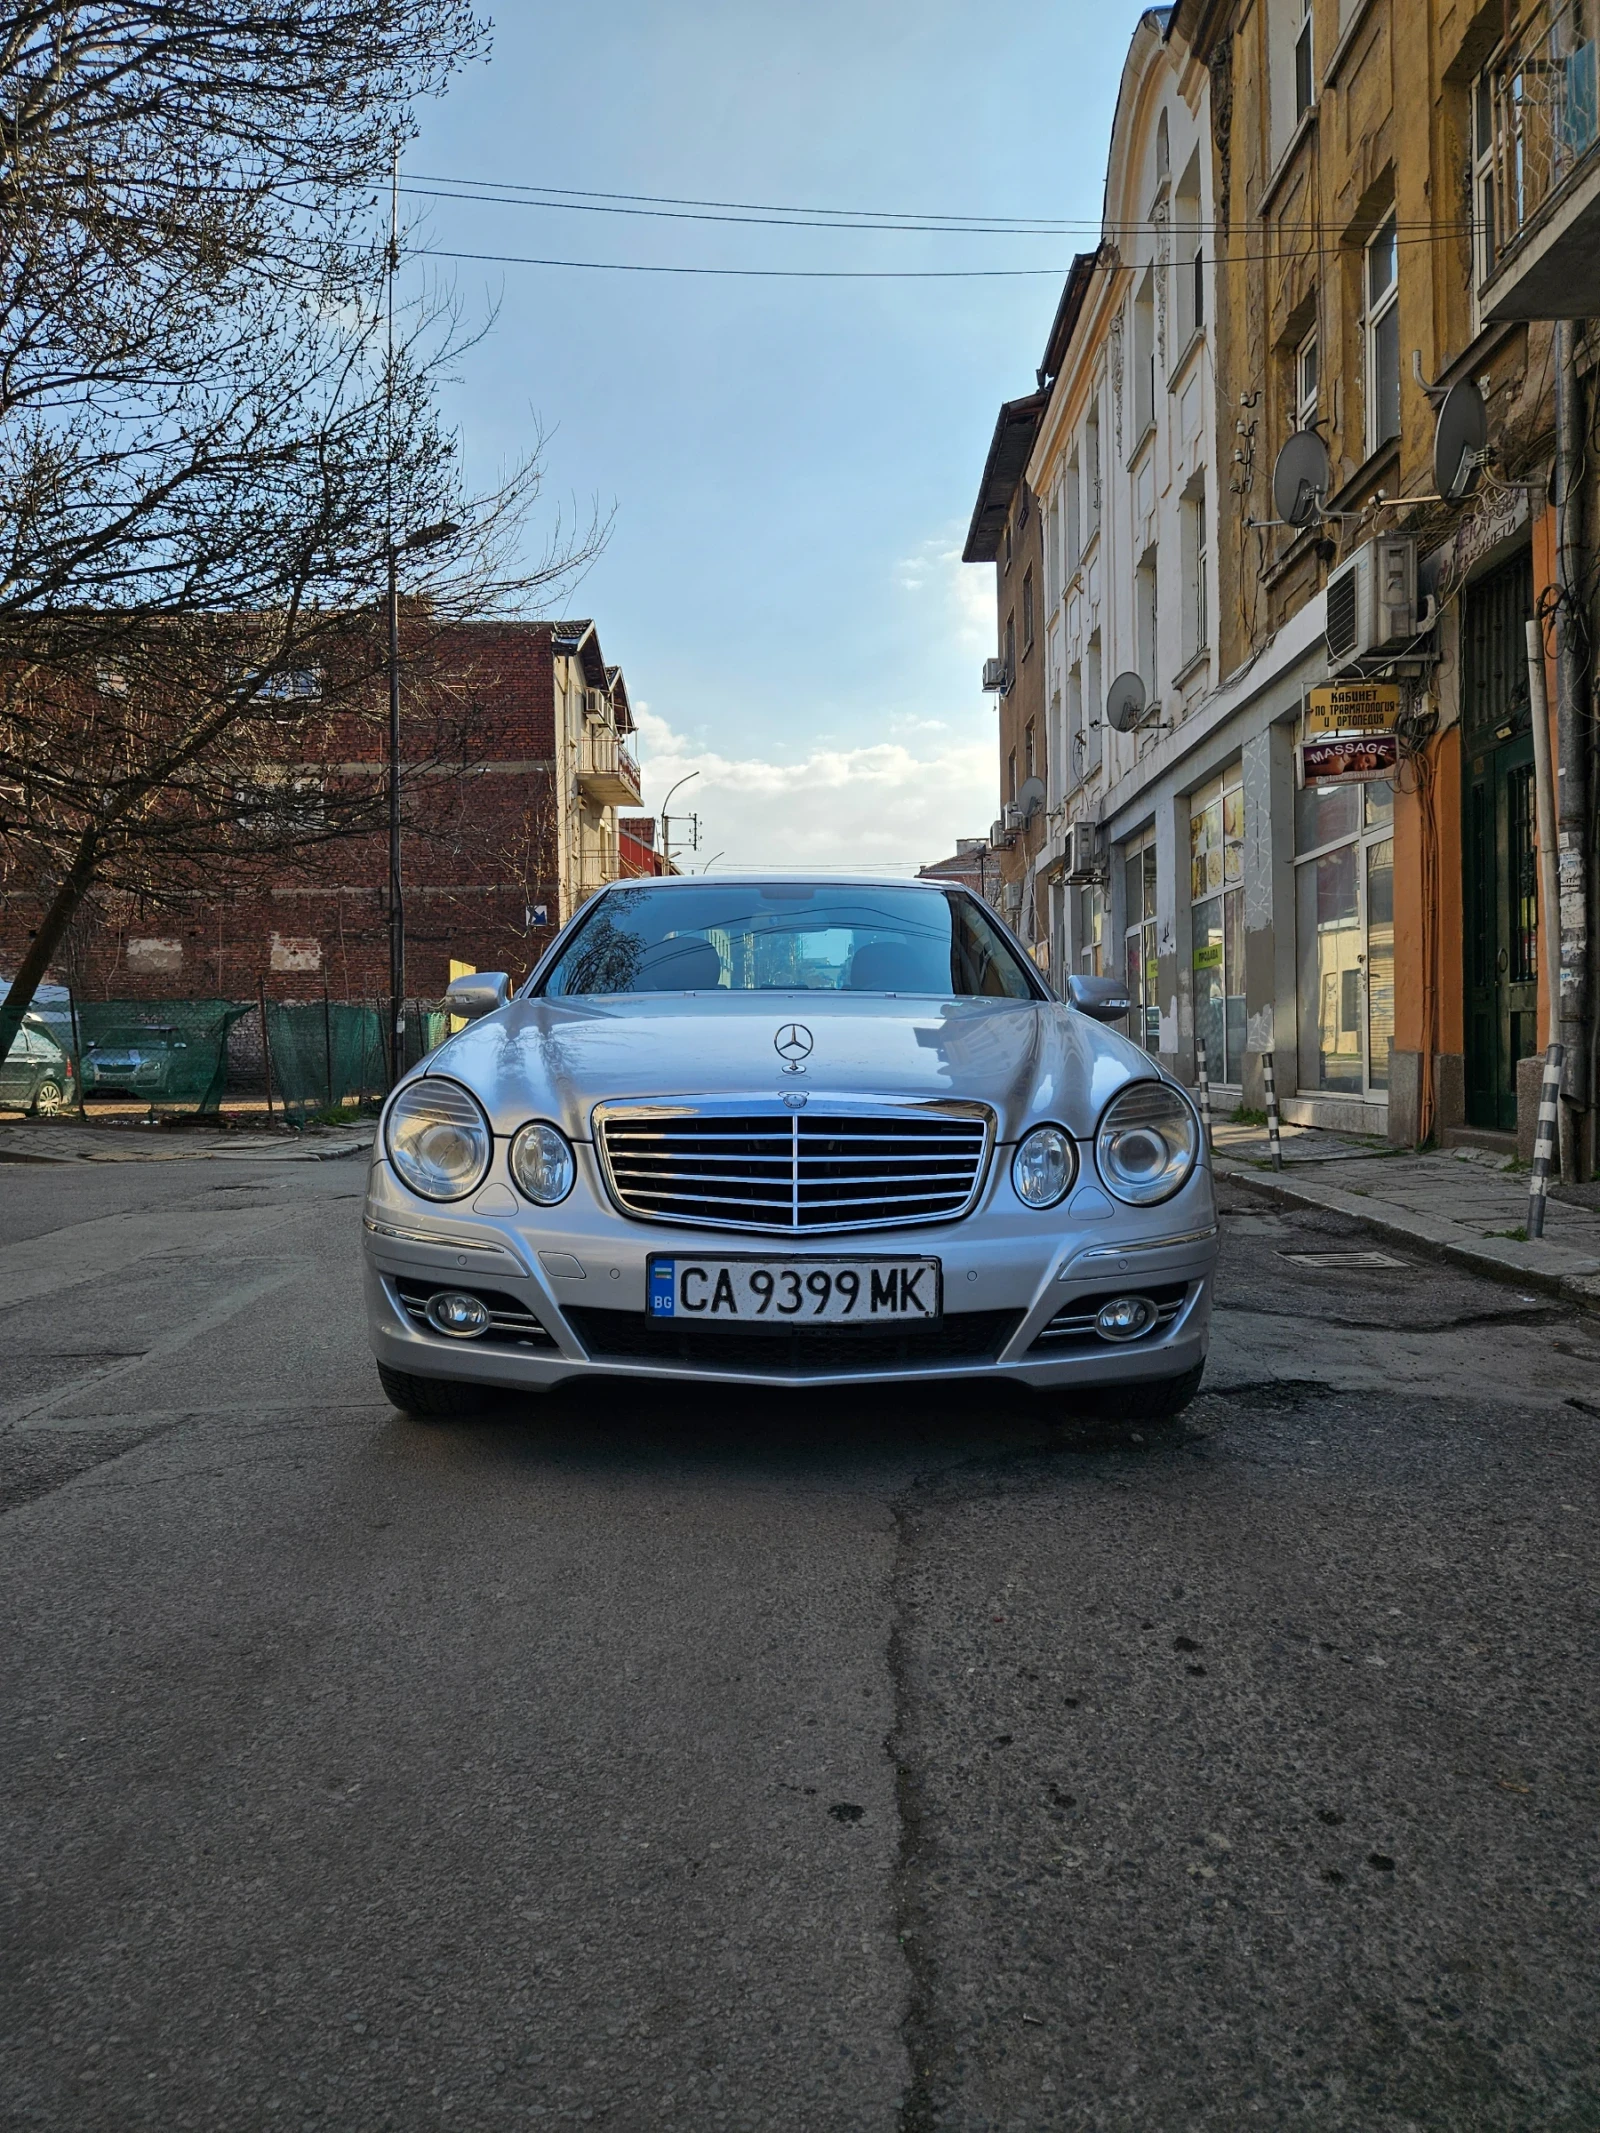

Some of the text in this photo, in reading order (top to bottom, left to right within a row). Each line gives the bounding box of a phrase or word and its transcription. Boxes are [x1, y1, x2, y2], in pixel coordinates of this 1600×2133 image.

[1331, 690, 1377, 703] КАБИНЕТ
[1315, 701, 1395, 716] ПО ТРАВМАТОЛОГИЯ
[1324, 714, 1384, 727] И ОРТОПЕДИЯ
[1311, 743, 1389, 763] MASSAGE
[681, 1267, 926, 1314] CA 9399 MK
[654, 1294, 672, 1309] BG
